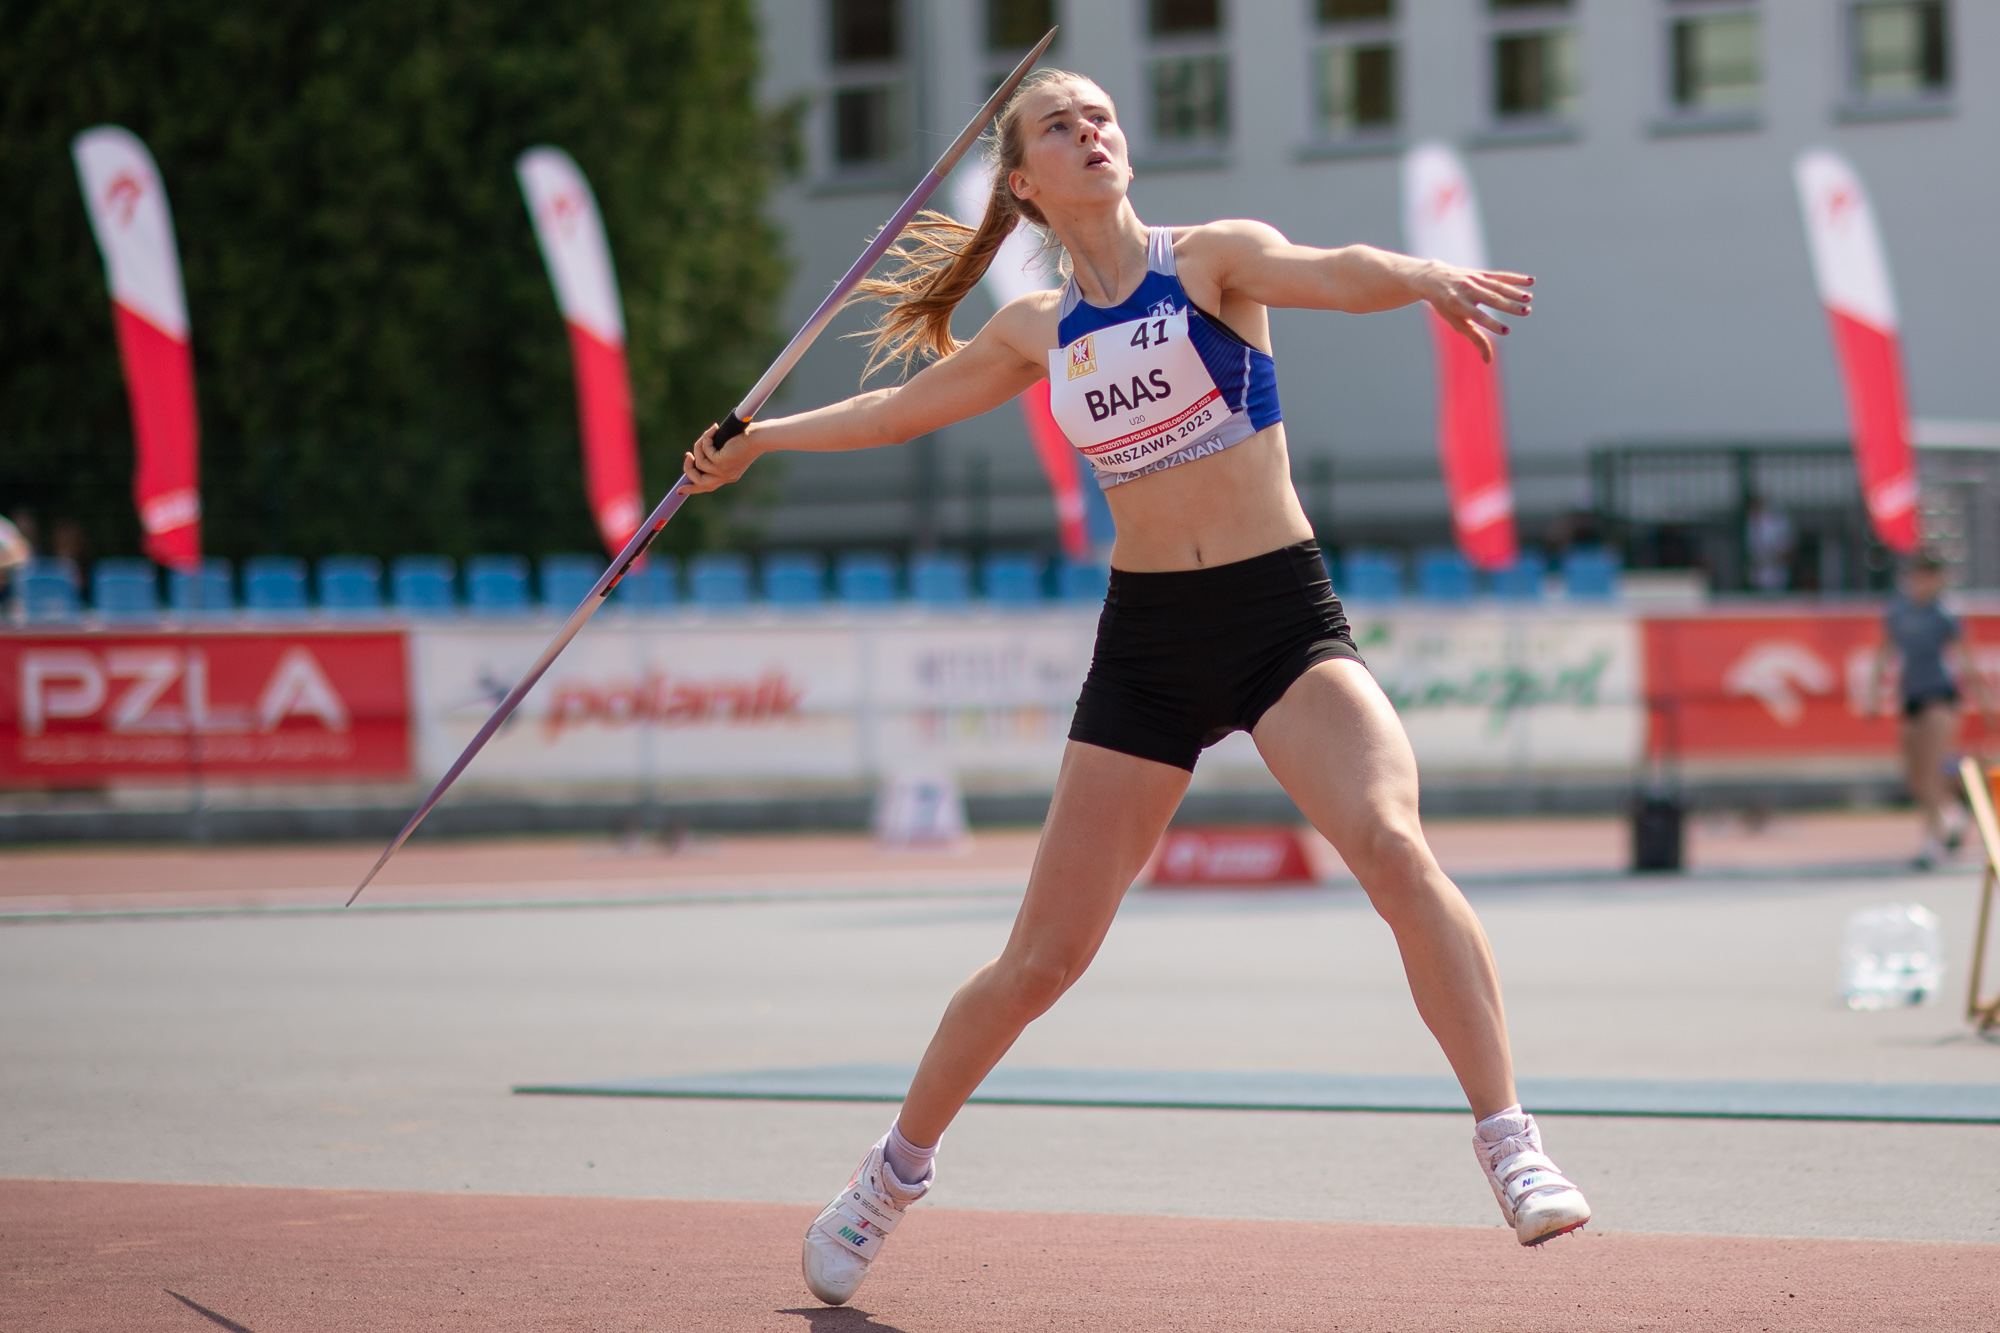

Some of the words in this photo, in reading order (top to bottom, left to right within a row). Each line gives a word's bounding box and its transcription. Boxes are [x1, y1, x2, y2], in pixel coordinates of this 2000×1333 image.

[1130, 319, 1169, 350] 41
[1069, 361, 1096, 379] PZLA
[1085, 368, 1172, 422] BAAS
[1096, 433, 1177, 466] WARSZAWA
[1178, 409, 1213, 438] 2023
[1129, 415, 1146, 426] U20
[1130, 429, 1152, 442] POLSKI
[1115, 470, 1142, 486] AZS
[1145, 433, 1225, 475] POZNAŃ
[22, 646, 351, 736] PZLA
[541, 662, 806, 746] polanik
[837, 1225, 869, 1247] NIKE
